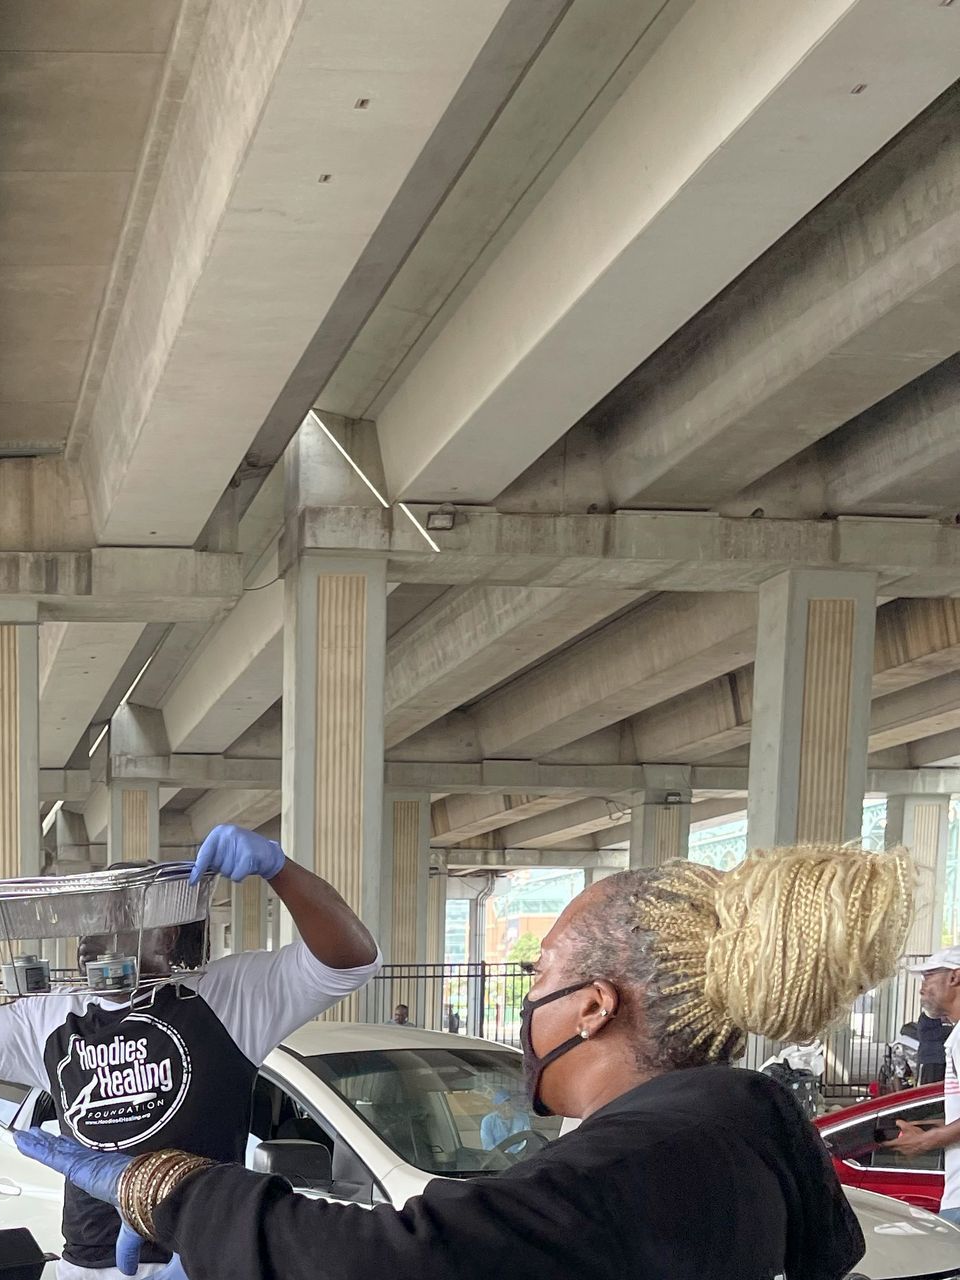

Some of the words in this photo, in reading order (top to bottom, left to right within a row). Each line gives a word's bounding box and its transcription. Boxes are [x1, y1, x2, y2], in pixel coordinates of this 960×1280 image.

[76, 1035, 147, 1071] Hoodies
[97, 1059, 173, 1098] Healing
[87, 1098, 165, 1119] FOUNDATION
